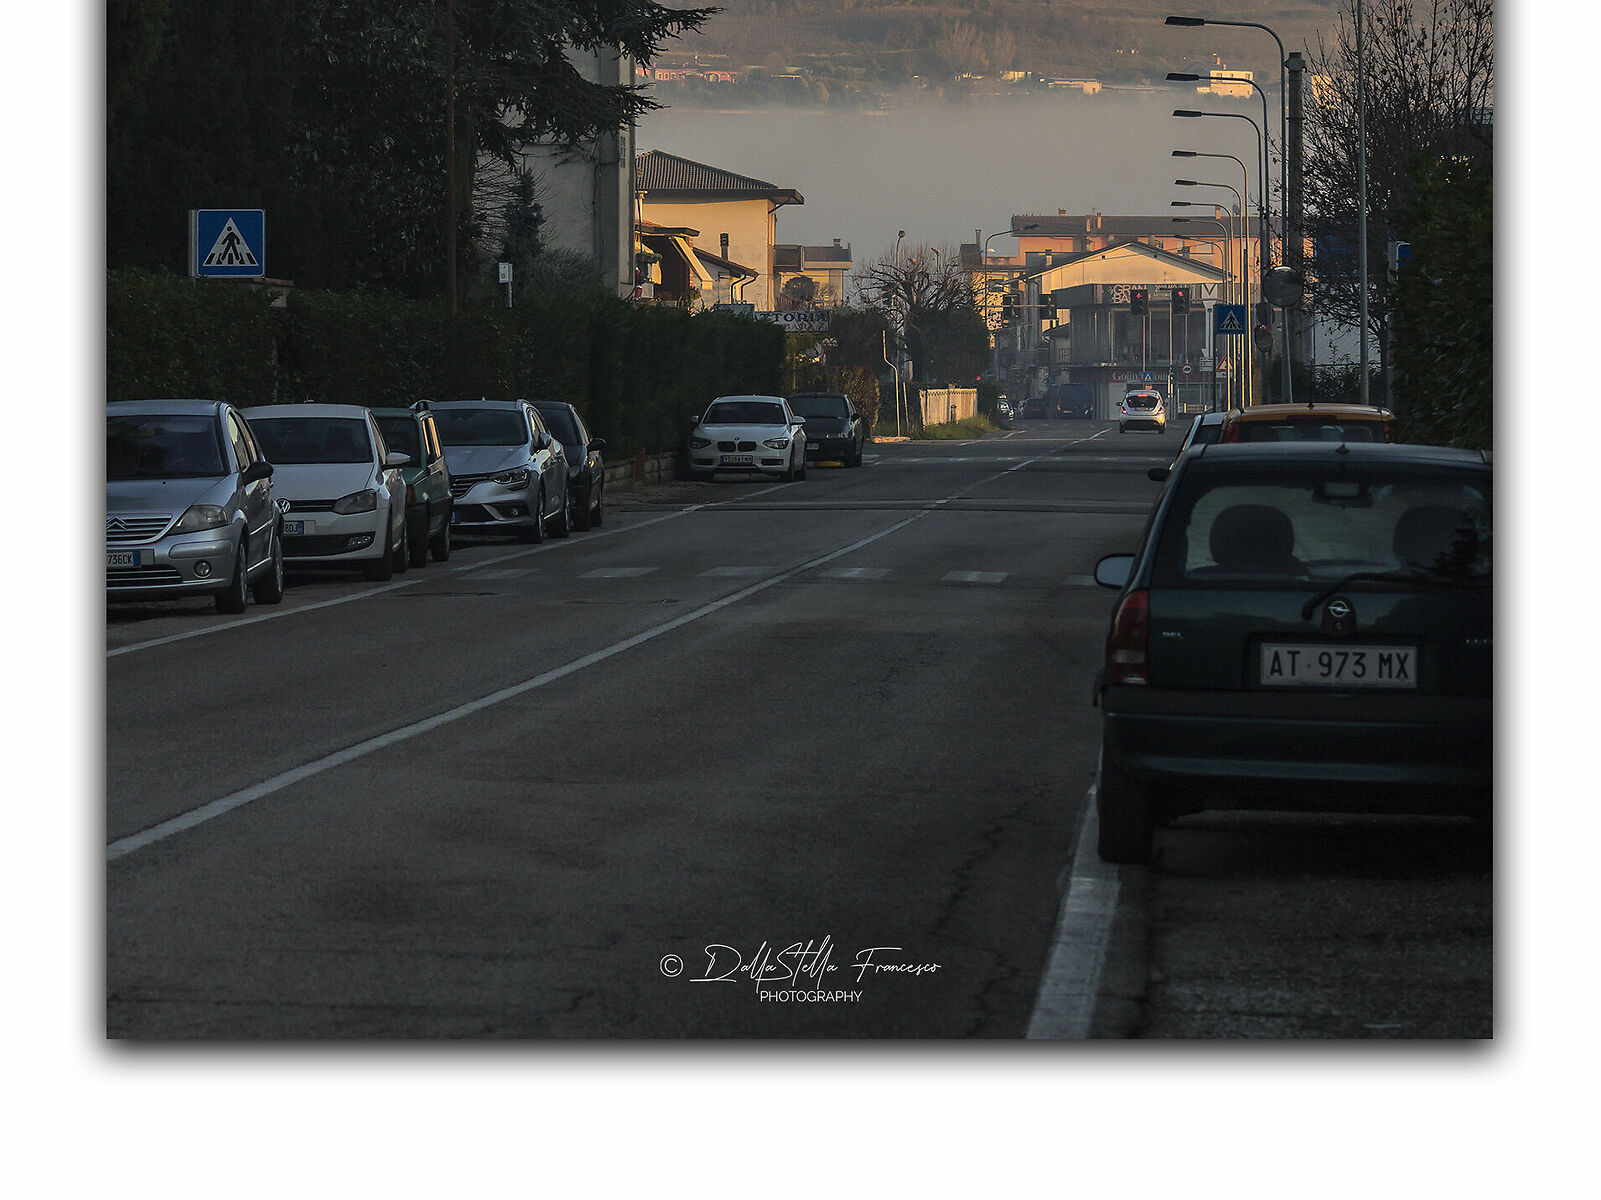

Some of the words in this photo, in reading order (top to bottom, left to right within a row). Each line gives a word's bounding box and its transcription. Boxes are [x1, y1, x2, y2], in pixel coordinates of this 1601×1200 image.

[1270, 650, 1300, 676] AT
[1318, 652, 1366, 678] 973
[1378, 653, 1409, 679] MX
